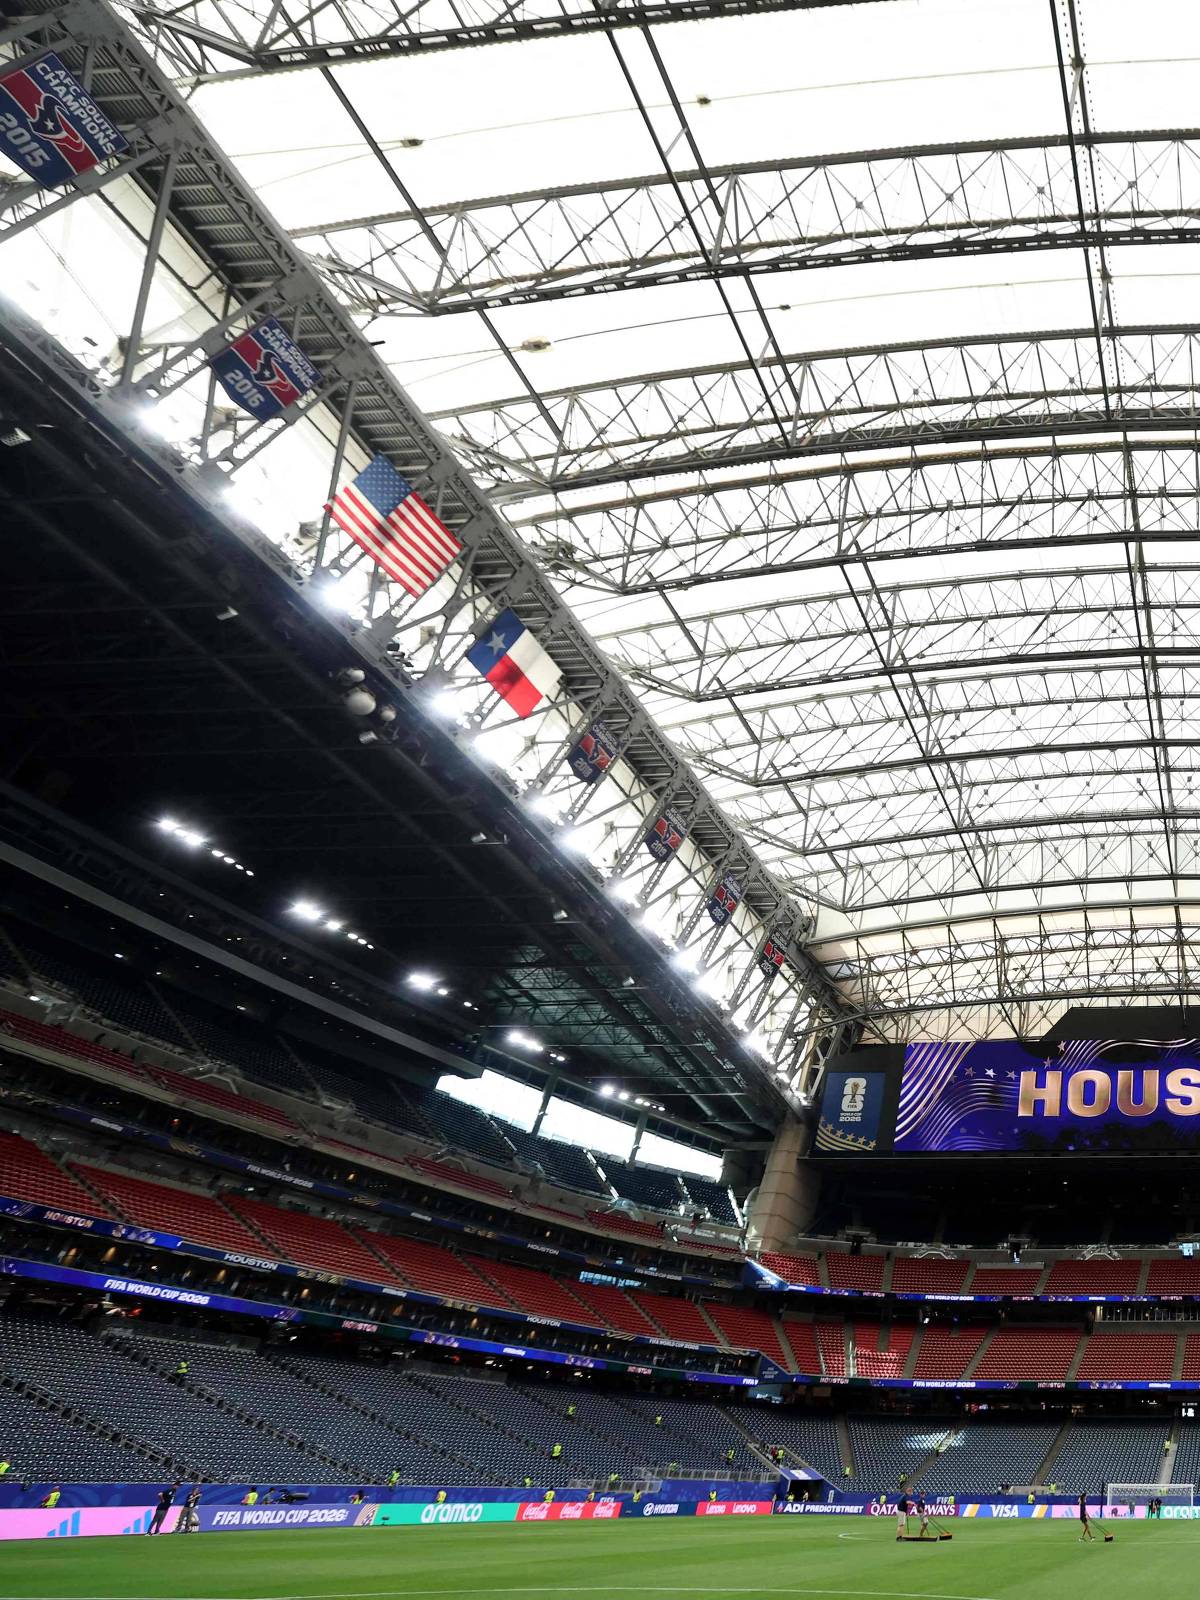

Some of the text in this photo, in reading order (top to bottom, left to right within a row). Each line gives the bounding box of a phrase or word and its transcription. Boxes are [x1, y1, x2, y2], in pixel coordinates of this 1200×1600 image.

[36, 63, 115, 155] CHAMPIONS
[55, 69, 117, 141] AFC SOUTH
[0, 112, 49, 168] 2015
[258, 325, 313, 389] CHAMPIONS
[271, 327, 315, 379] AFC SOUTH
[223, 370, 263, 407] 2016
[44, 1210, 94, 1228] HOUSTON
[527, 1243, 560, 1256] HOUSTON
[224, 1253, 279, 1270] HOUSTON
[104, 1278, 210, 1304] FIFA WORLD CUP 2026
[527, 1316, 561, 1328] HOUSTON
[212, 1511, 242, 1525] FIFA
[242, 1510, 285, 1524] WORLD
[285, 1510, 309, 1523] CUP
[308, 1508, 346, 1522] 2026
[420, 1503, 483, 1523] aramco
[654, 1504, 680, 1514] HYUNDAI
[733, 1504, 757, 1513] Lenovo
[784, 1504, 805, 1513] ADI
[871, 1504, 956, 1516] QATA AWAYS
[990, 1505, 1019, 1517] VISA
